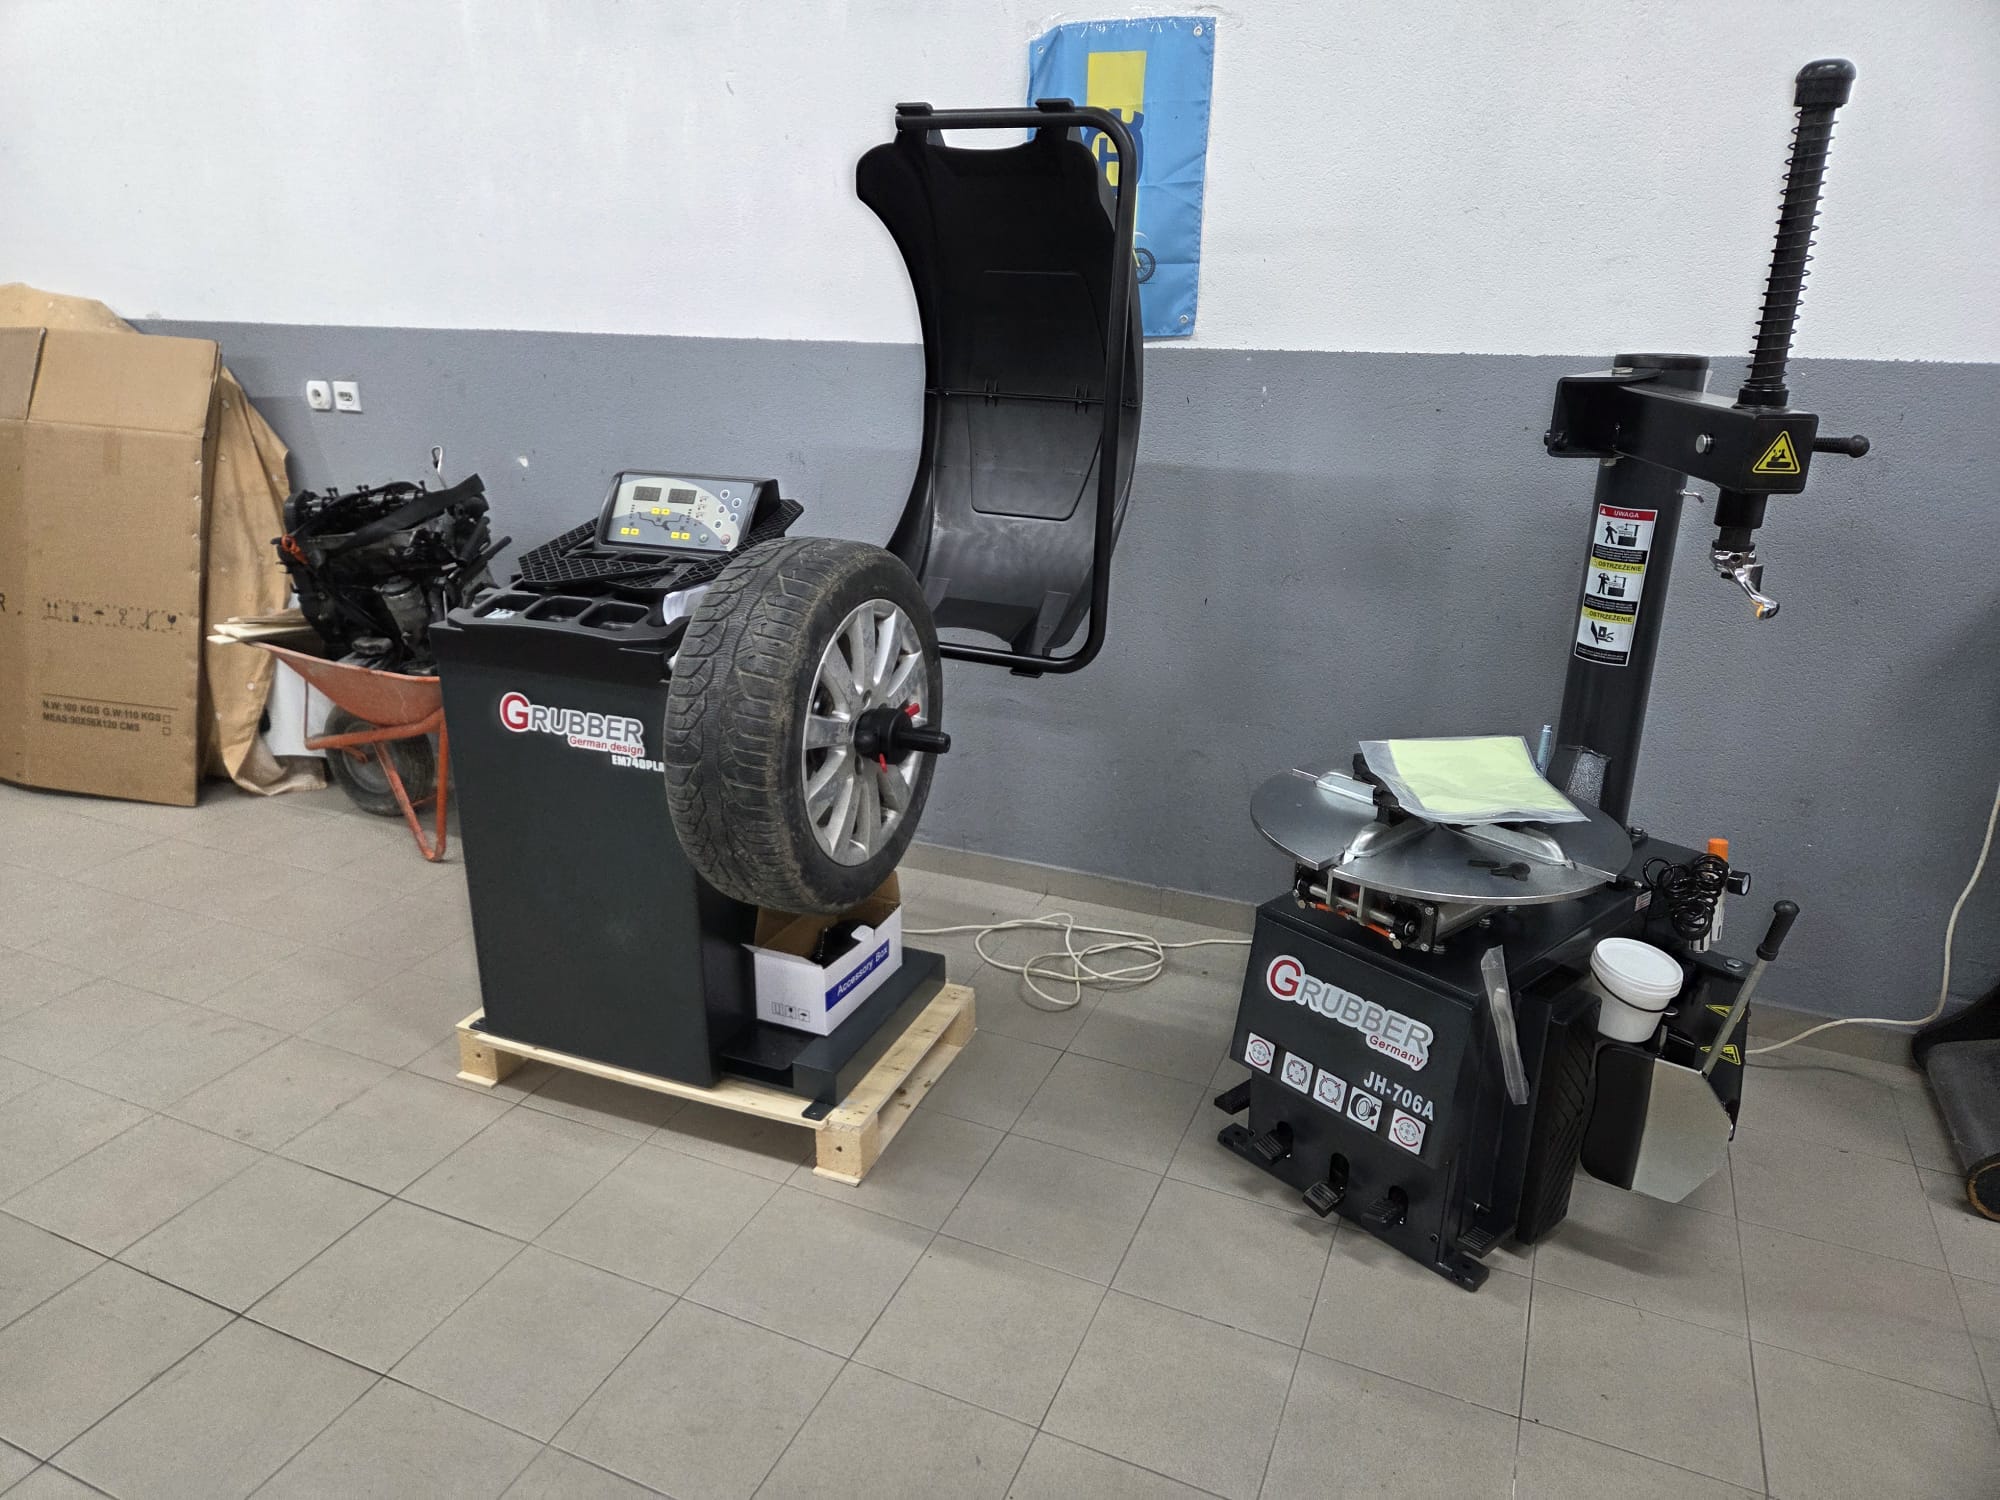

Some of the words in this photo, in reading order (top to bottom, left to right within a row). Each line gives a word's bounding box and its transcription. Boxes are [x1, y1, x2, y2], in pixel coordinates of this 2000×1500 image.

[1614, 510, 1639, 518] UWAGA
[1597, 560, 1643, 572] OSTRZEŻENIE
[1589, 610, 1633, 622] OSTRZEŻENIE
[80, 704, 99, 714] KGS
[141, 711, 161, 722] KGS
[501, 693, 642, 744] GRUBBER
[120, 721, 140, 732] CMS
[569, 735, 607, 749] German
[610, 742, 643, 756] design
[837, 959, 873, 996] Accessory
[875, 946, 888, 963] Box
[1269, 959, 1429, 1054] GRUBBER
[1369, 1035, 1423, 1066] Germany
[1363, 1071, 1434, 1121] JH-706A
